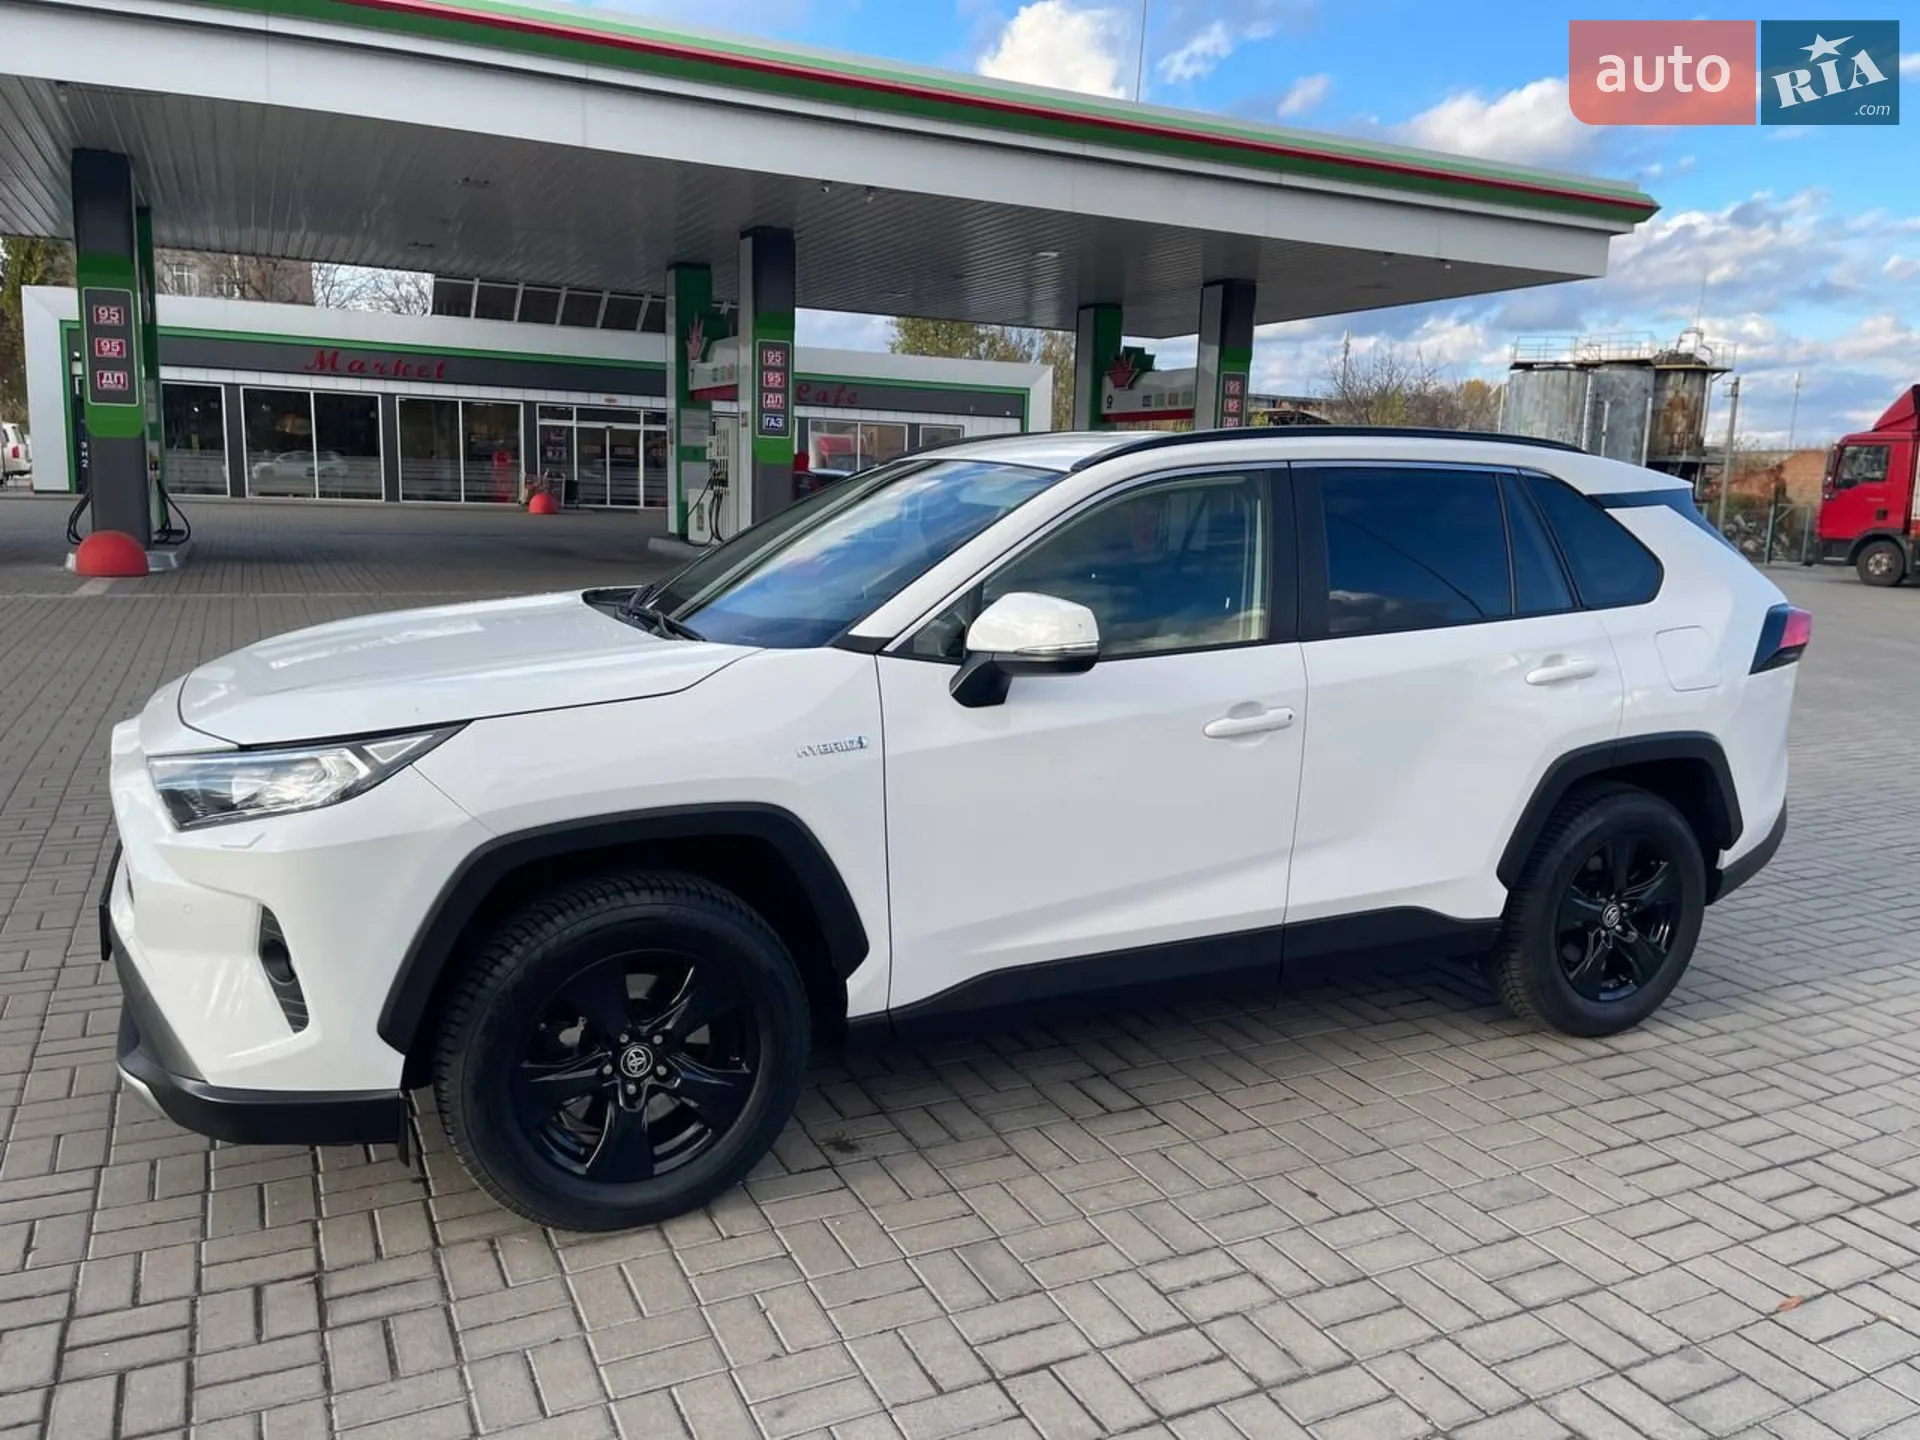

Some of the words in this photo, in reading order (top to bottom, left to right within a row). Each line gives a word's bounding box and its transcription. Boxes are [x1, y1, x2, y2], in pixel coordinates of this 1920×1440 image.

[98, 306, 119, 320] 95
[101, 340, 120, 353] 95
[767, 350, 782, 363] 95
[303, 350, 444, 380] Market
[102, 372, 124, 386] ДП
[767, 373, 781, 384] 95
[765, 417, 784, 427] ГАЗ
[796, 739, 857, 758] HYBRID
